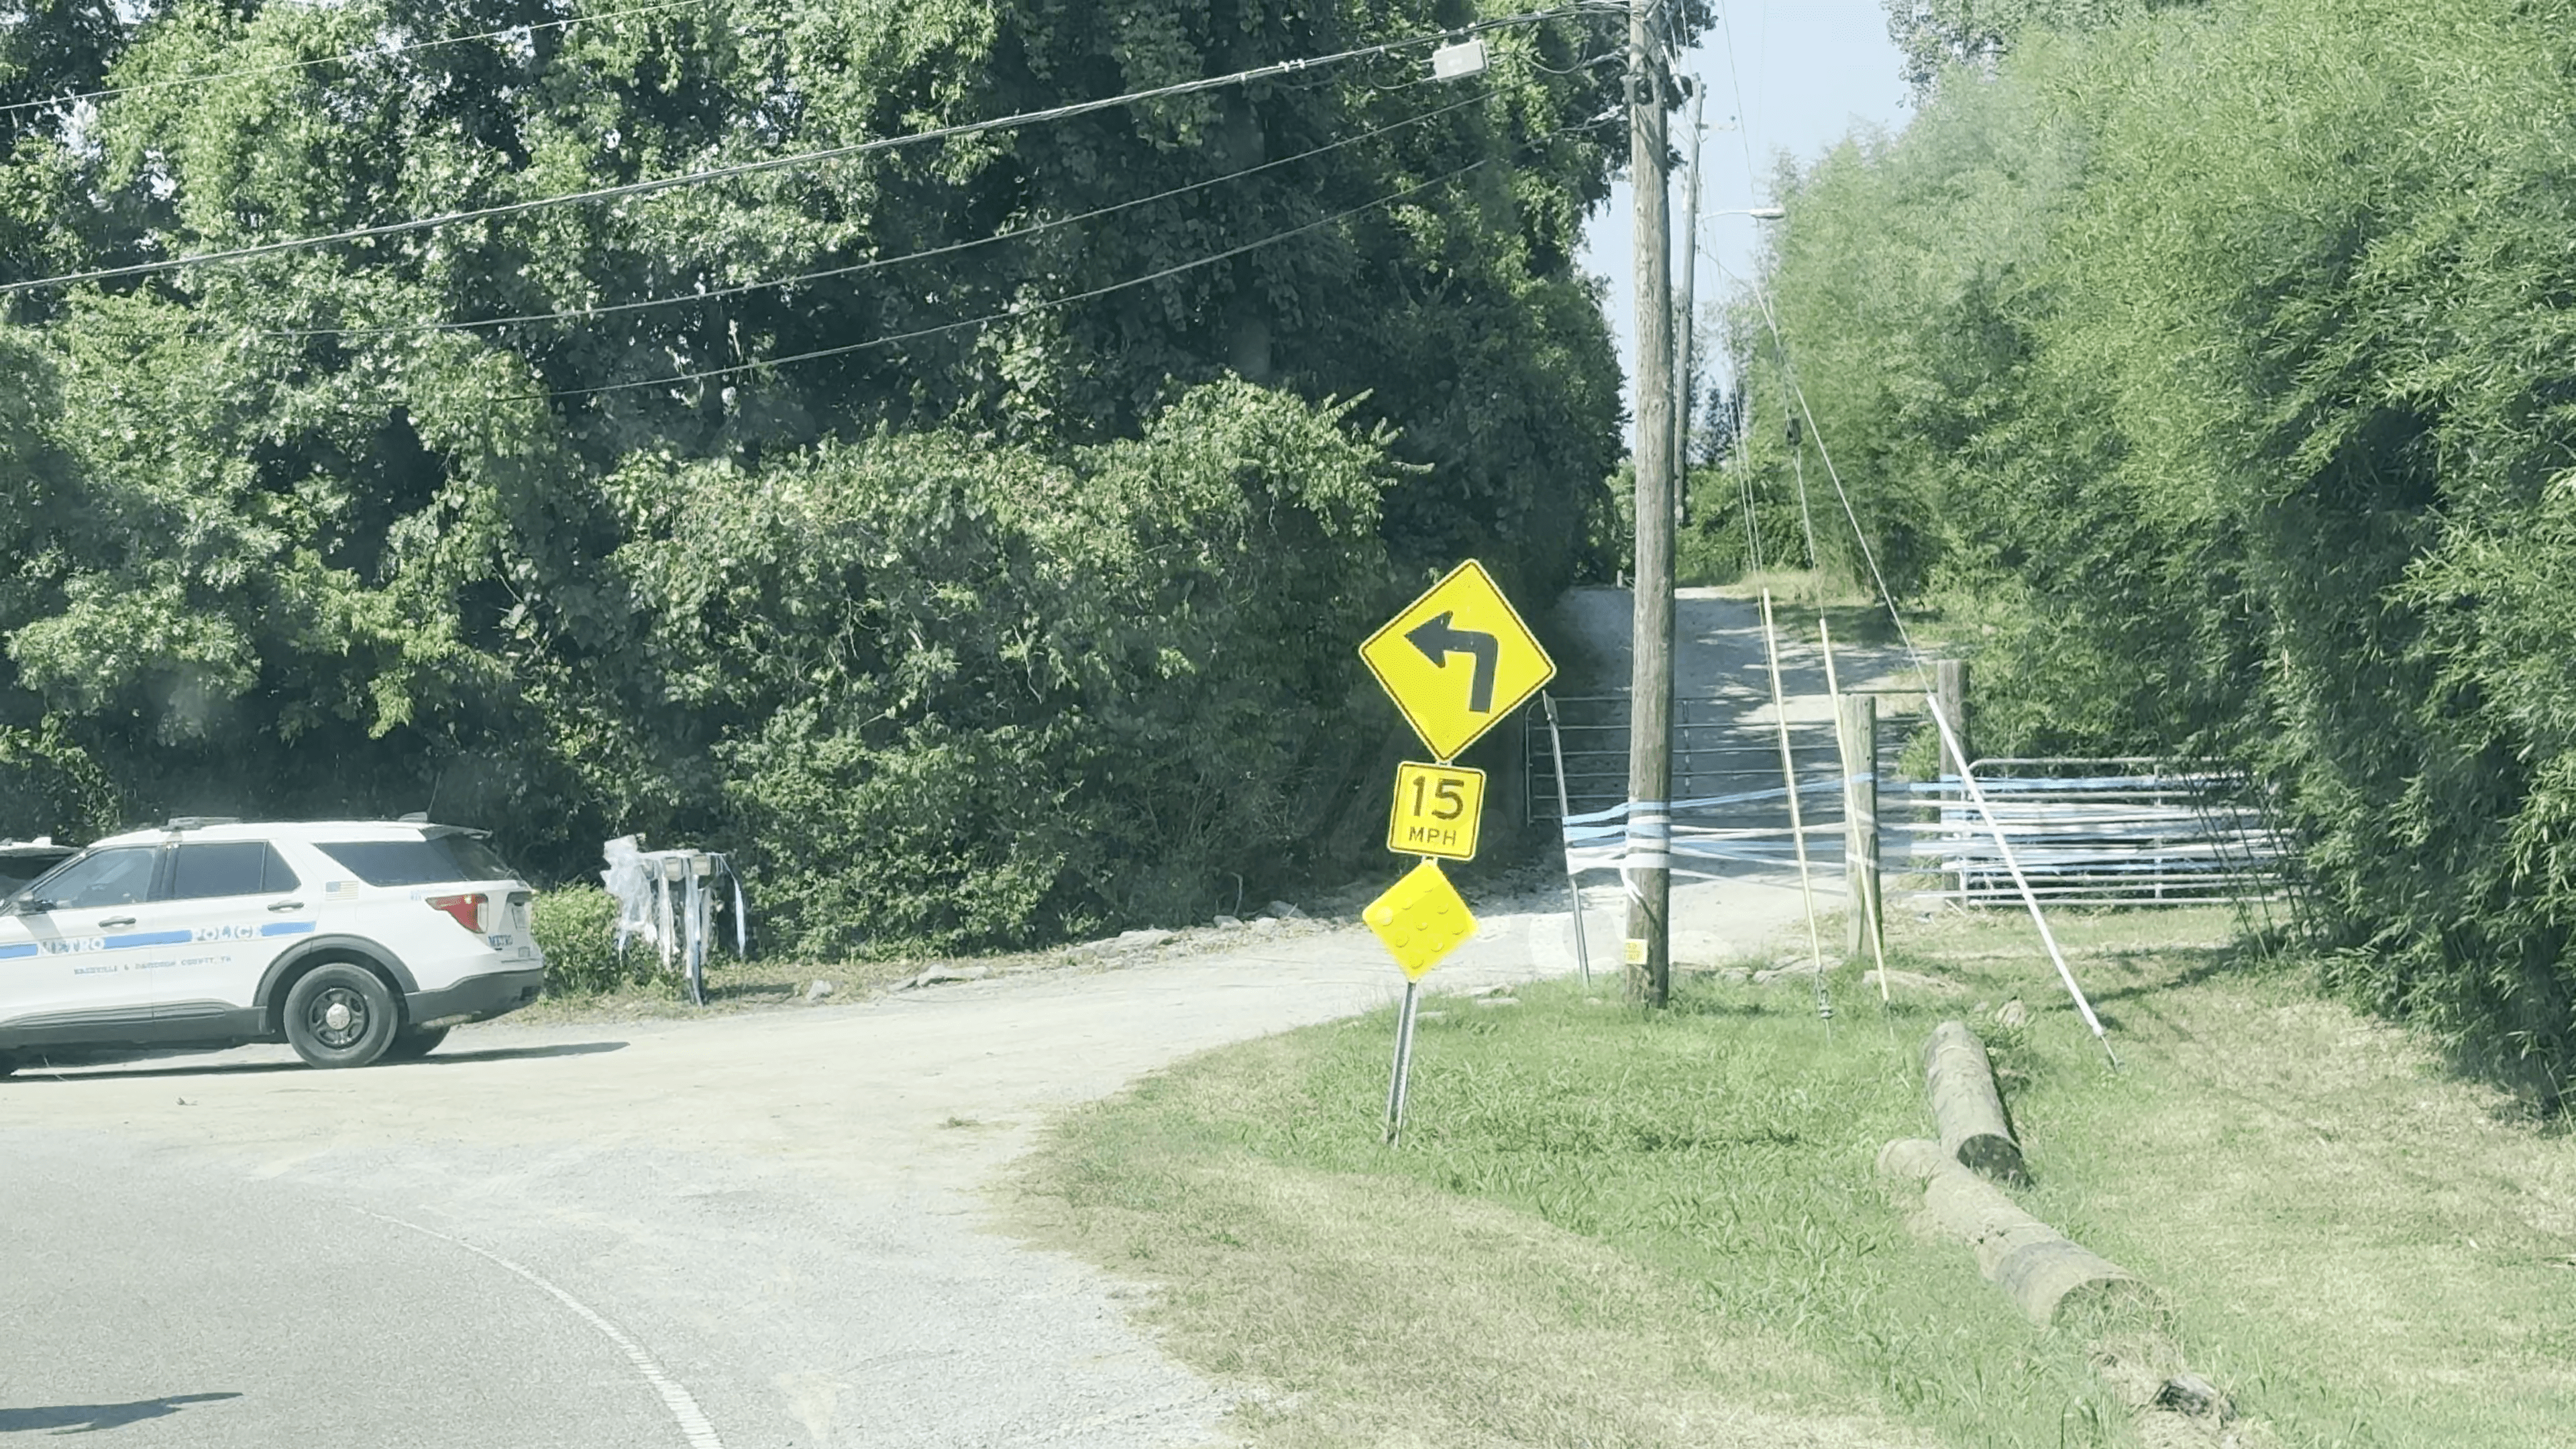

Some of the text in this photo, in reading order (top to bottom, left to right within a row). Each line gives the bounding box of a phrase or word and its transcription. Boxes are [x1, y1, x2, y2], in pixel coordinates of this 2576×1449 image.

[1413, 775, 1464, 820] 15
[1409, 826, 1456, 847] MPH
[38, 924, 262, 956] METRO POLICE
